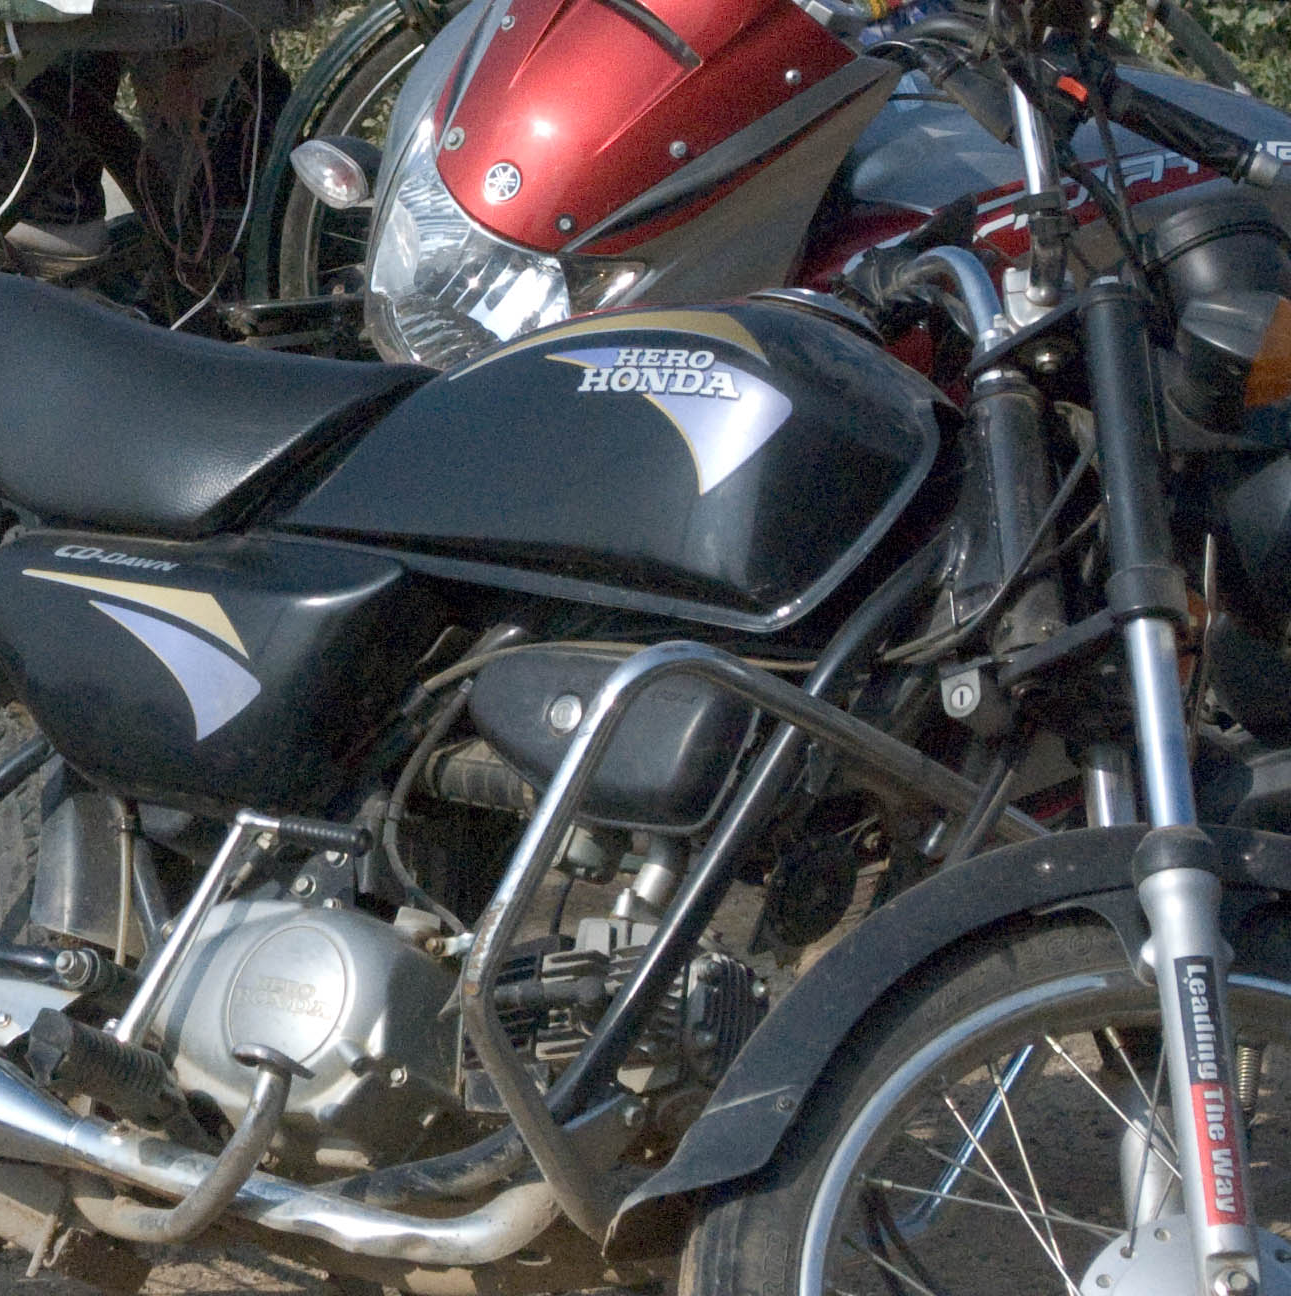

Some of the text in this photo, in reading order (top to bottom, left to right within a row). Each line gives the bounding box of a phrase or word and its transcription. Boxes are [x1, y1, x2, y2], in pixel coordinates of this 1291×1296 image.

[614, 348, 716, 370] HERO
[577, 367, 740, 400] HONDA
[1185, 964, 1237, 1215] Leading The Way
